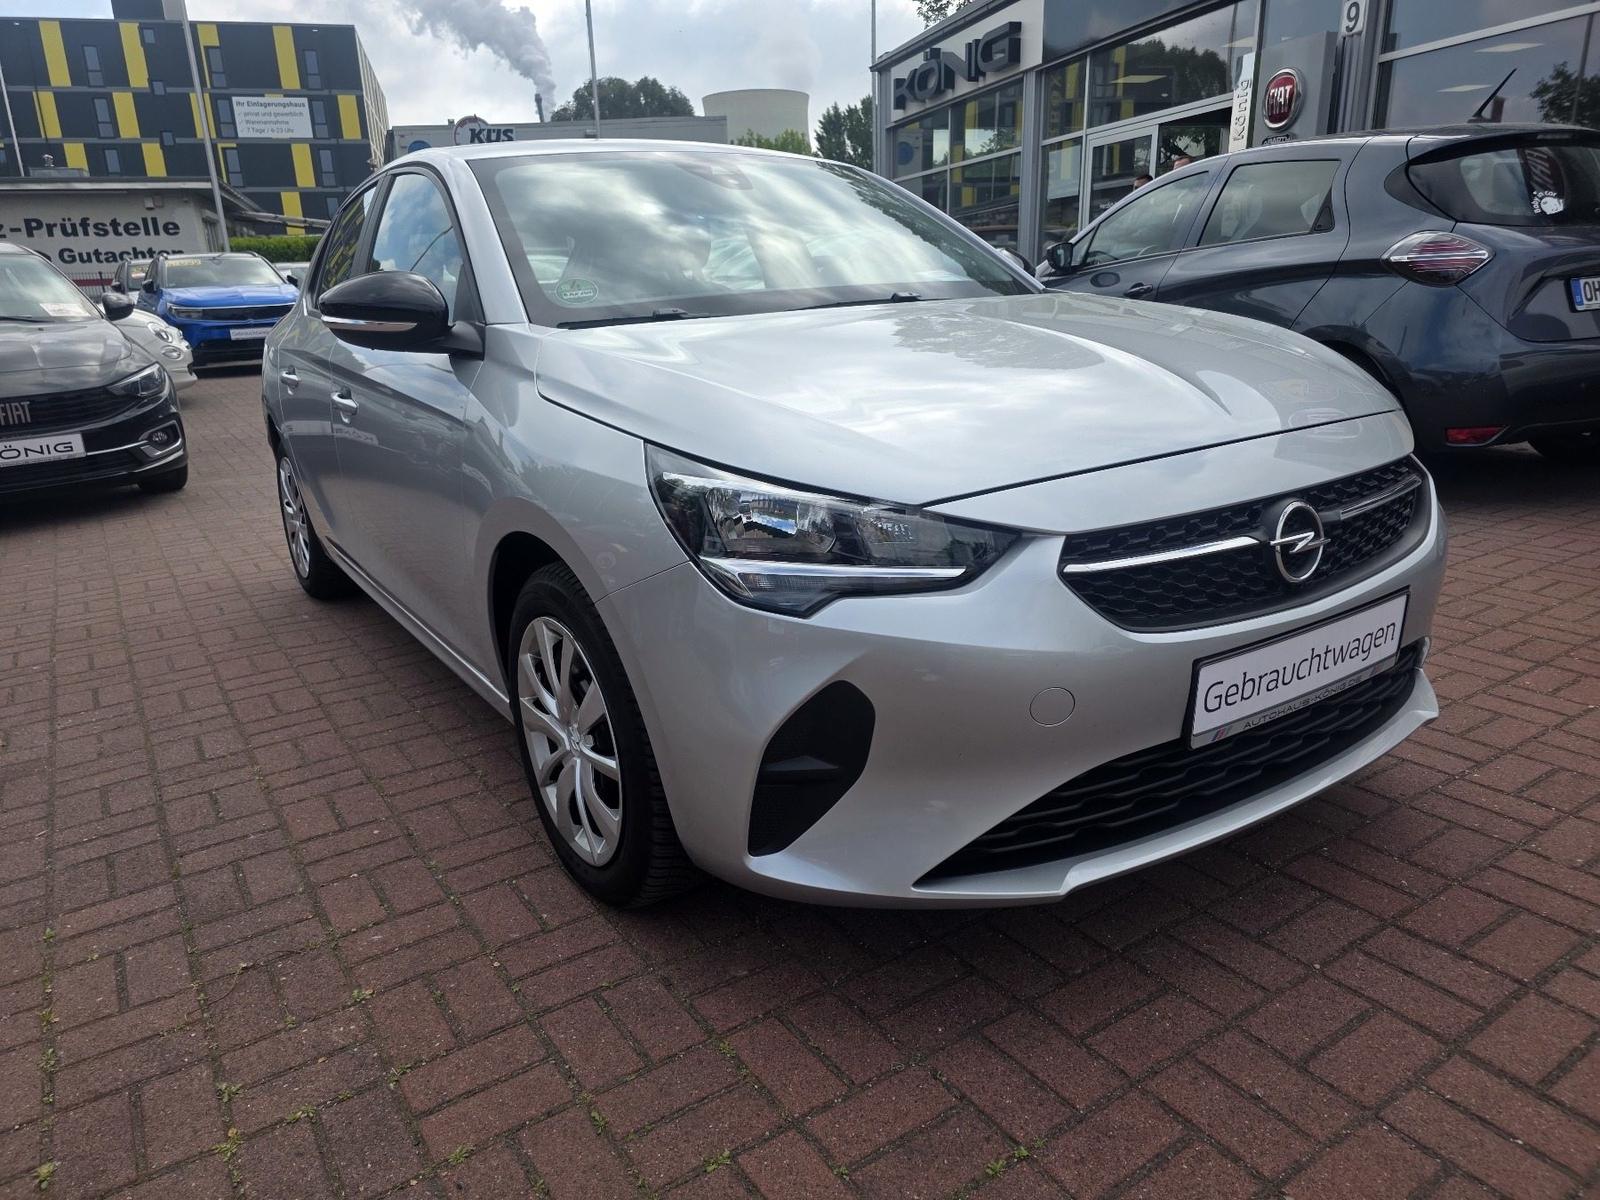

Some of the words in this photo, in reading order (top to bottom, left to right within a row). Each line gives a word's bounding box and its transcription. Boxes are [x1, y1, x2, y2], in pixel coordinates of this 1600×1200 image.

[1345, 1, 1360, 32] 9
[893, 21, 1022, 110] KÖNIG
[1232, 79, 1252, 142] König
[1267, 84, 1294, 116] FIAT
[0, 401, 31, 426] FIAT
[1203, 621, 1396, 714] Gebrauchtwagen
